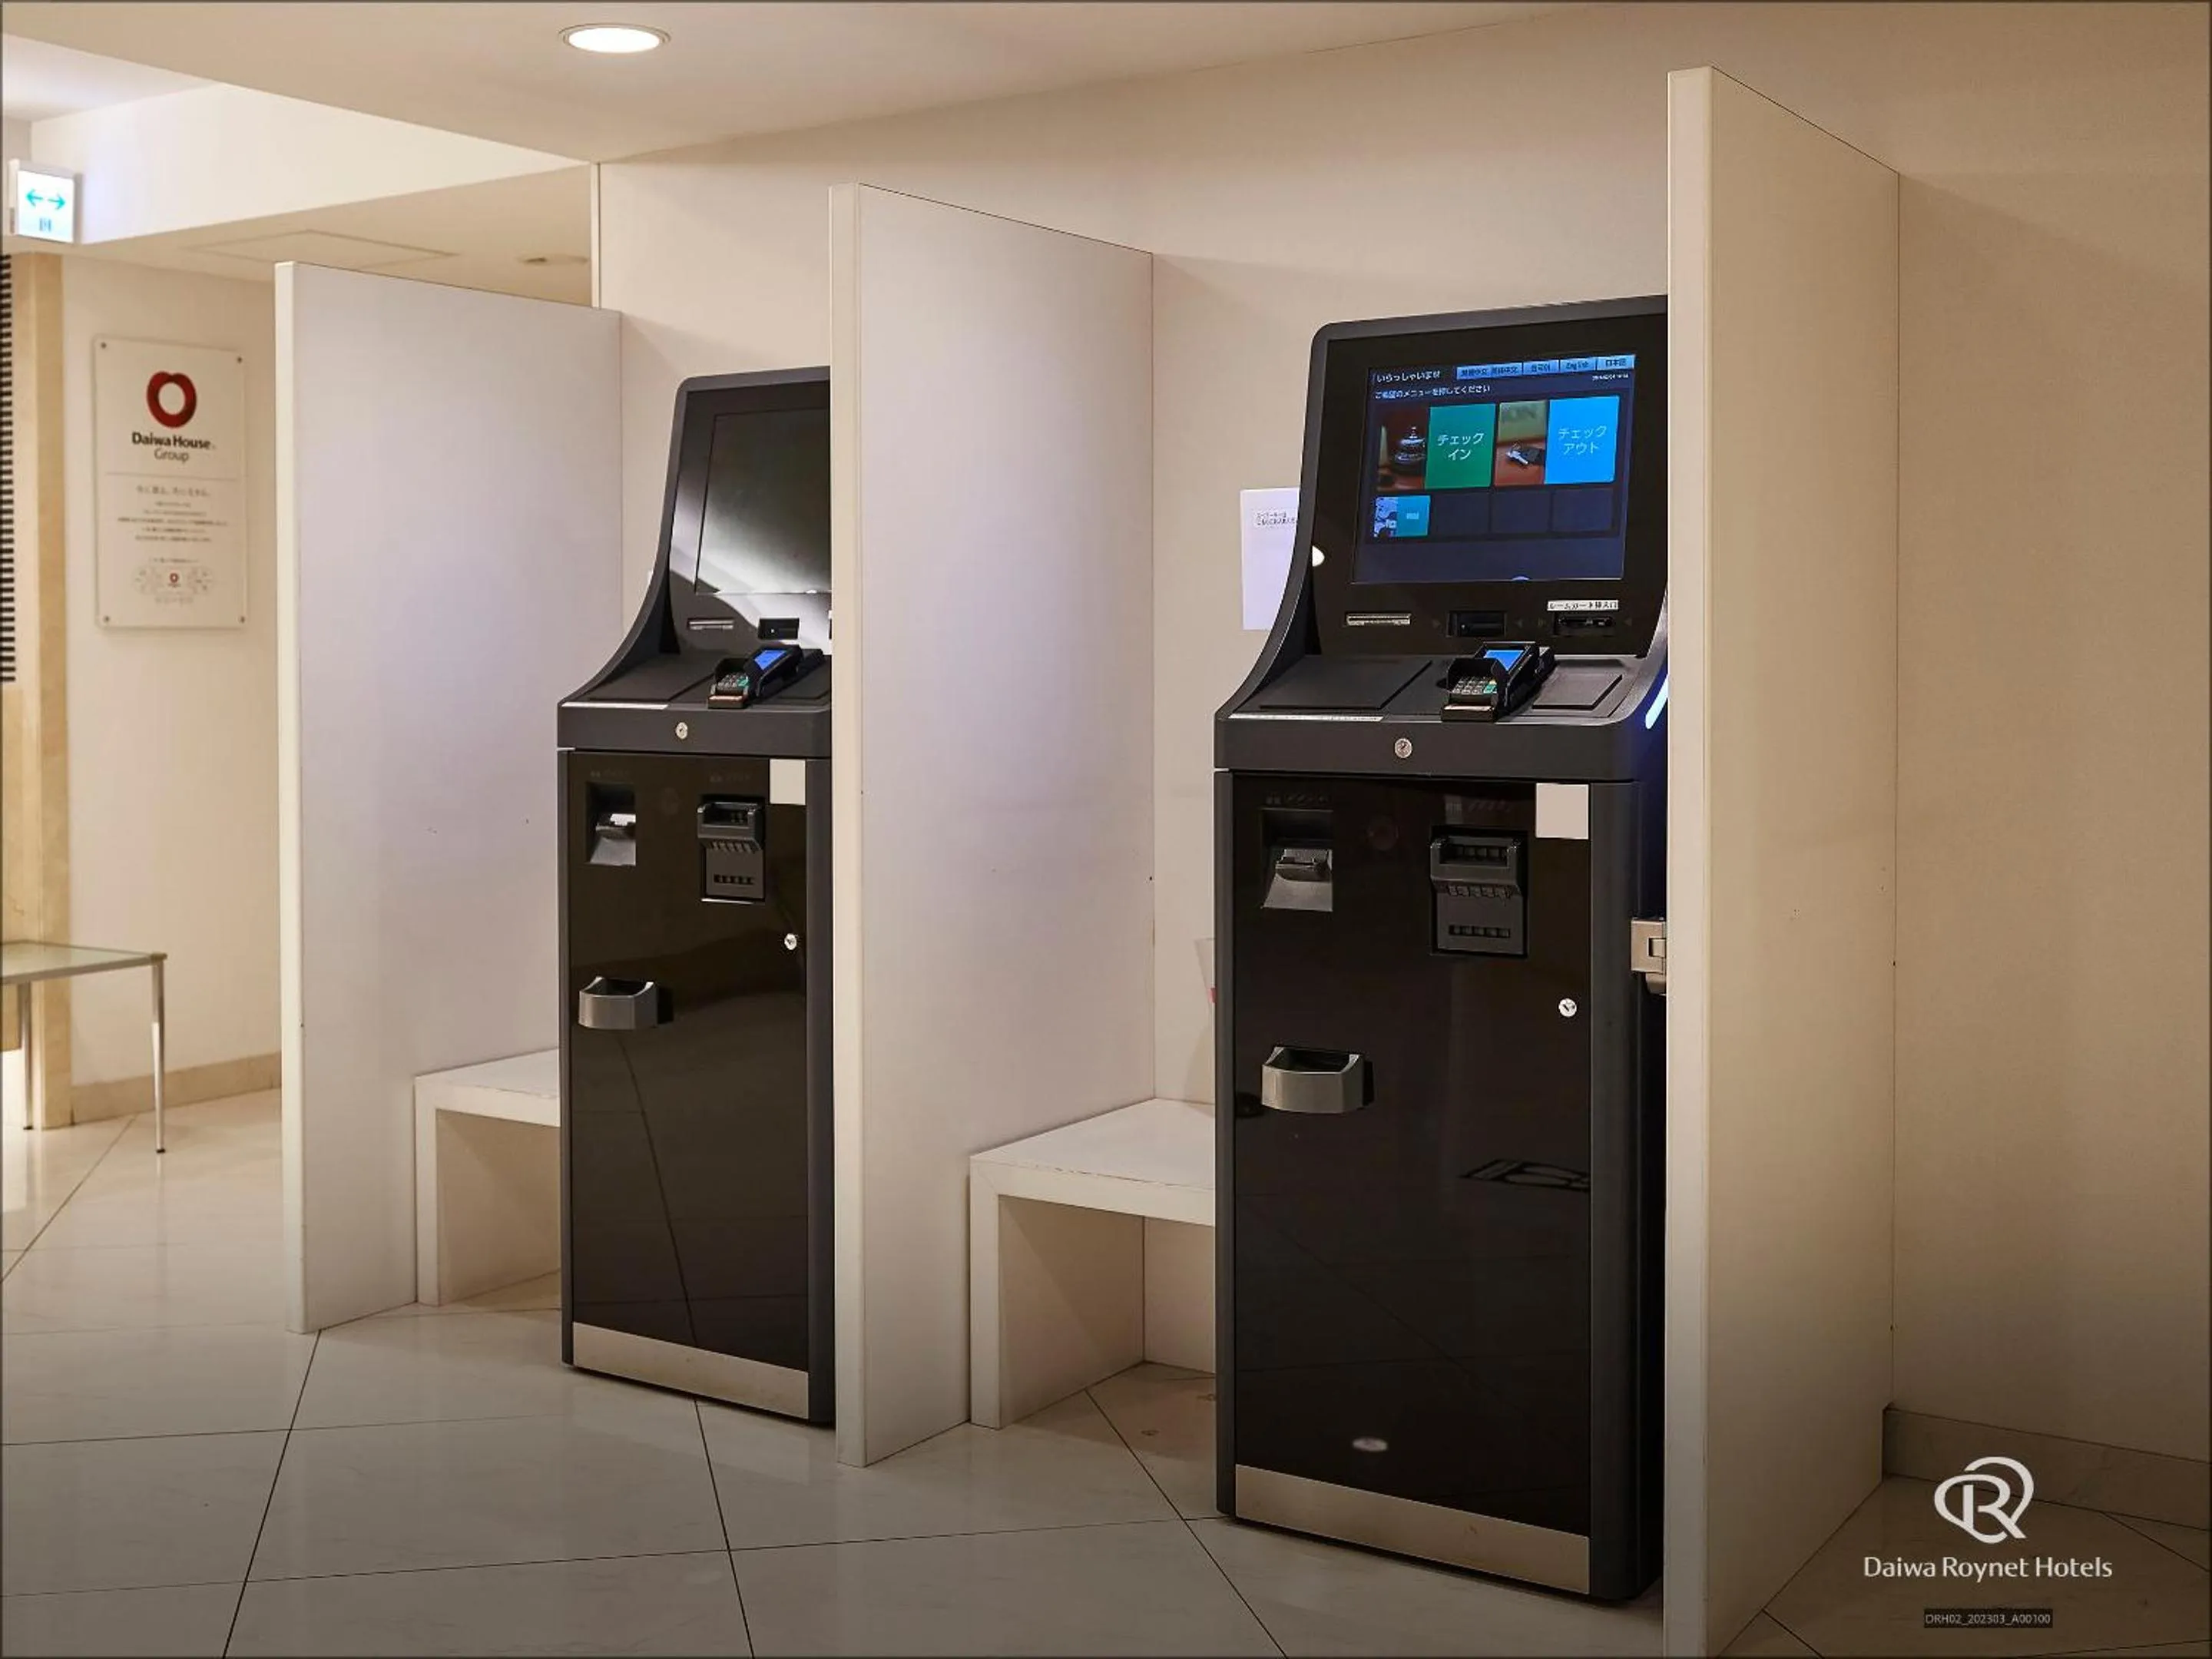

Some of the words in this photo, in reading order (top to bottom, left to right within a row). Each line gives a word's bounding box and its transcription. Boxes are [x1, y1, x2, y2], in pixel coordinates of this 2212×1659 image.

[1605, 357, 1627, 367] 日本語
[1376, 369, 1441, 383] いらっしゃいませ
[131, 431, 171, 446] Daiwa
[173, 434, 211, 449] House
[1436, 432, 1485, 446] チェック
[1558, 425, 1608, 441] チェック
[154, 448, 190, 463] Group
[1448, 449, 1472, 461] イン
[1563, 442, 1599, 455] アウト
